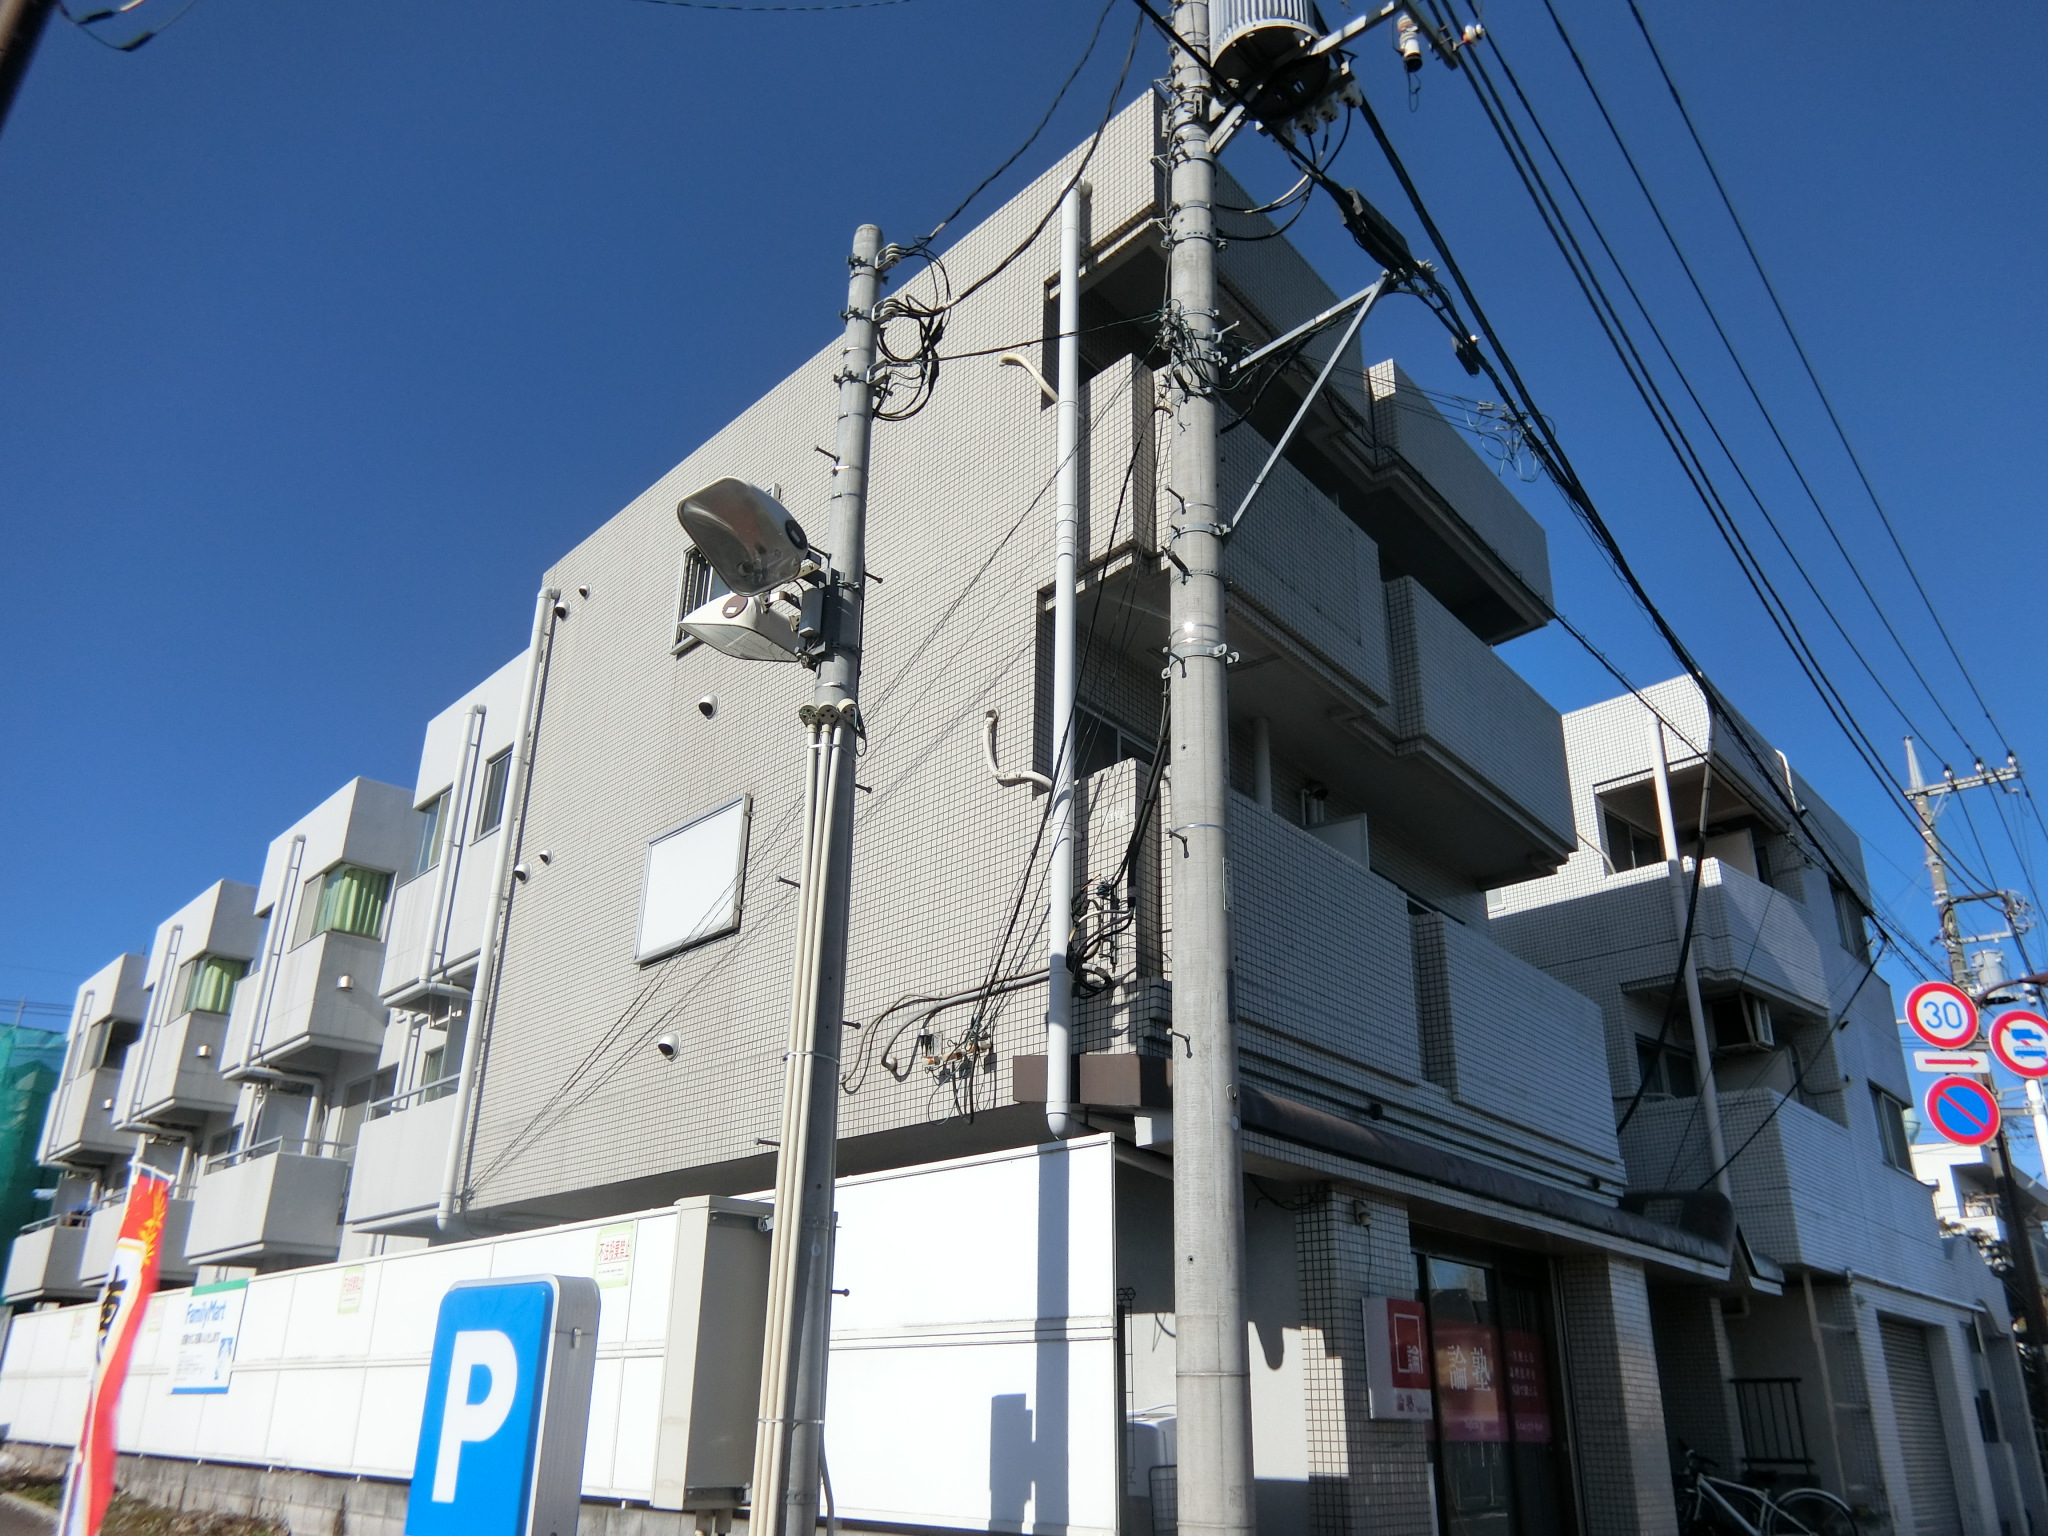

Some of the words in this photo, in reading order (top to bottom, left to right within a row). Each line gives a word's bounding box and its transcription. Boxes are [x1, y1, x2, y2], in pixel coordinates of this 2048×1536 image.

[1924, 1001, 1962, 1029] 30
[598, 1239, 631, 1263] 不法投棄禁止
[184, 1299, 227, 1329] FamilyMart
[1447, 1344, 1492, 1392] 論塾
[431, 1330, 518, 1504] P
